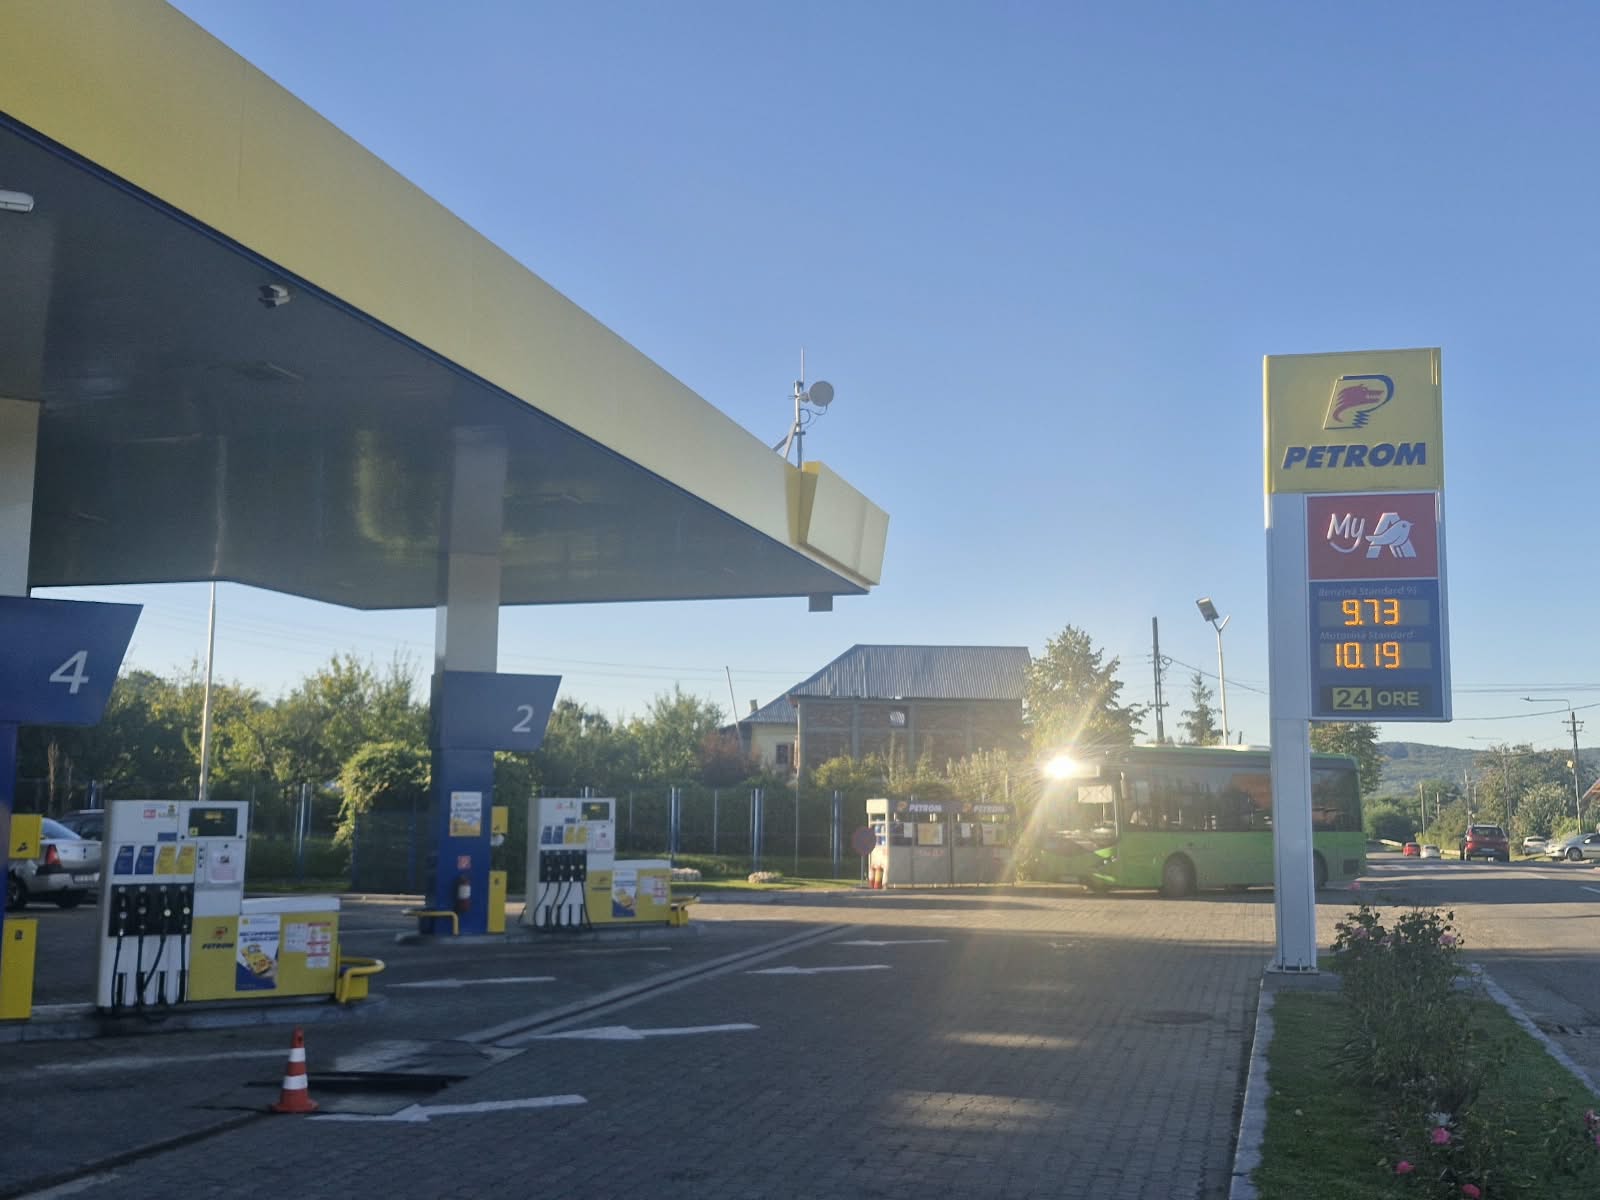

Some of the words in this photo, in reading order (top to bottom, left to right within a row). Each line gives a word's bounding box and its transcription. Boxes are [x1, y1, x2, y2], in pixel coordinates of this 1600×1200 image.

[1281, 441, 1426, 470] PETROM
[1326, 512, 1366, 553] My
[1342, 598, 1400, 626] 9.73
[1335, 641, 1401, 669] 10.19
[49, 650, 89, 694] 4
[1336, 689, 1369, 708] 24
[1377, 690, 1419, 706] ORE
[511, 704, 534, 733] 2
